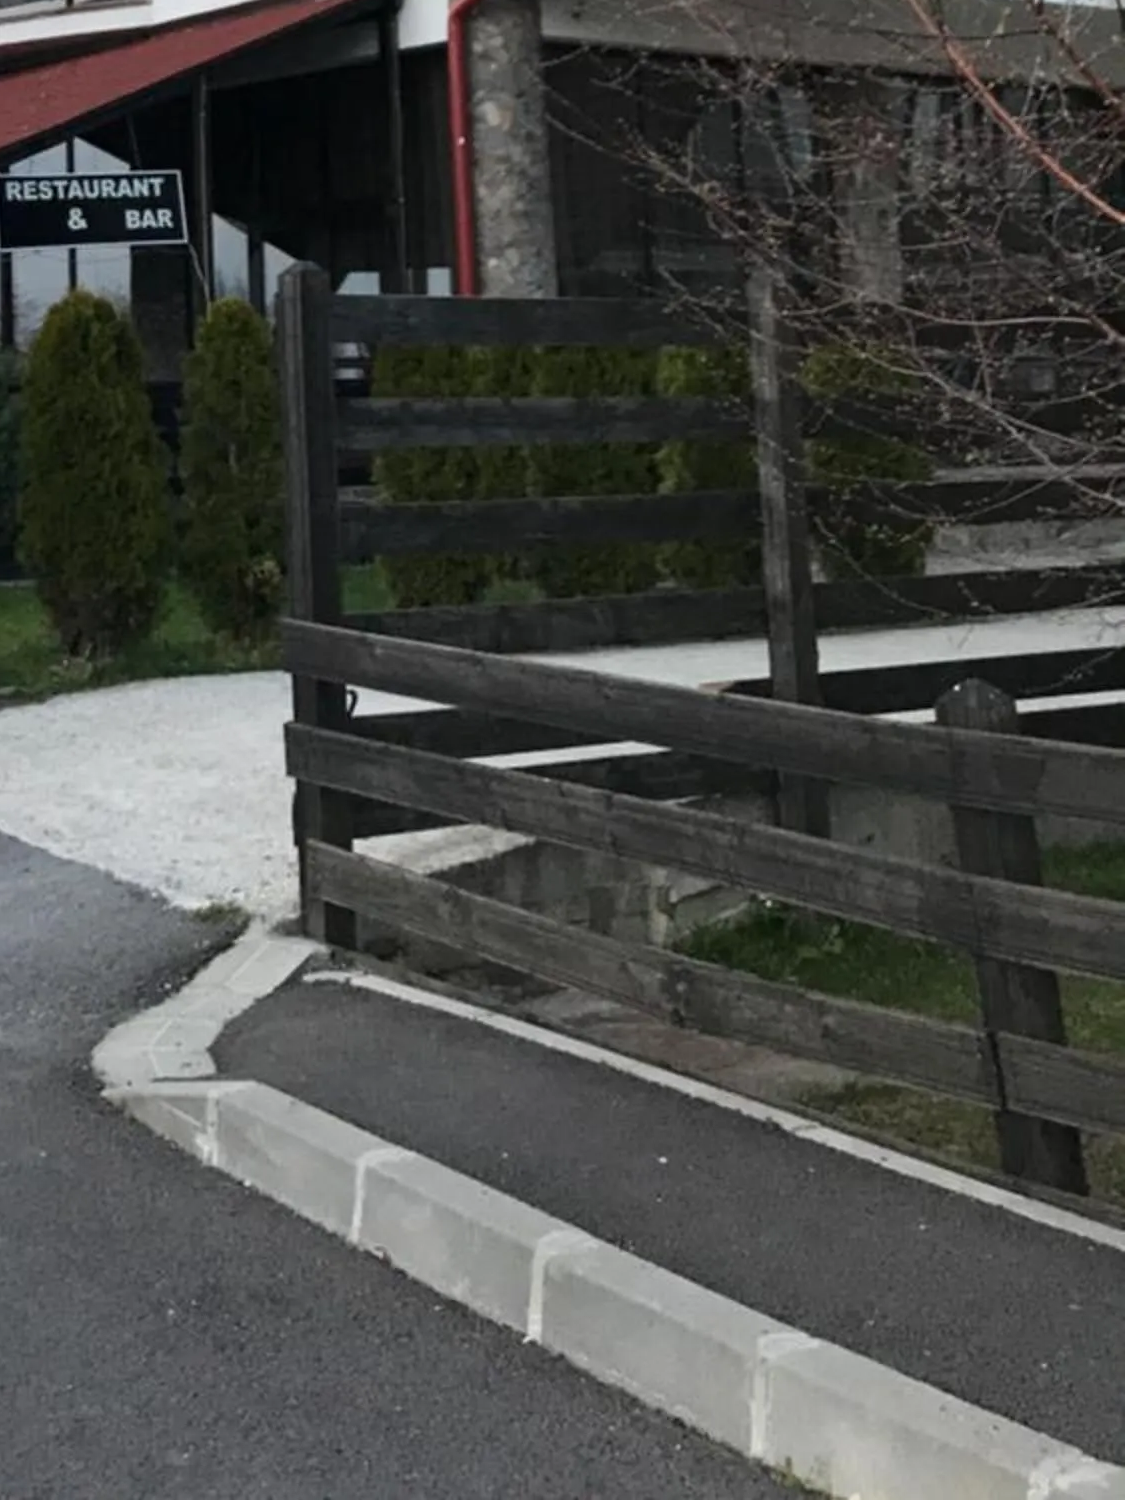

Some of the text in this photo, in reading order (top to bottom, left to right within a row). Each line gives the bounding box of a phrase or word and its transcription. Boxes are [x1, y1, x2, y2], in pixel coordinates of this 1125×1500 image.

[5, 178, 164, 200] RESTAURANT
[67, 208, 174, 230] & BAR
